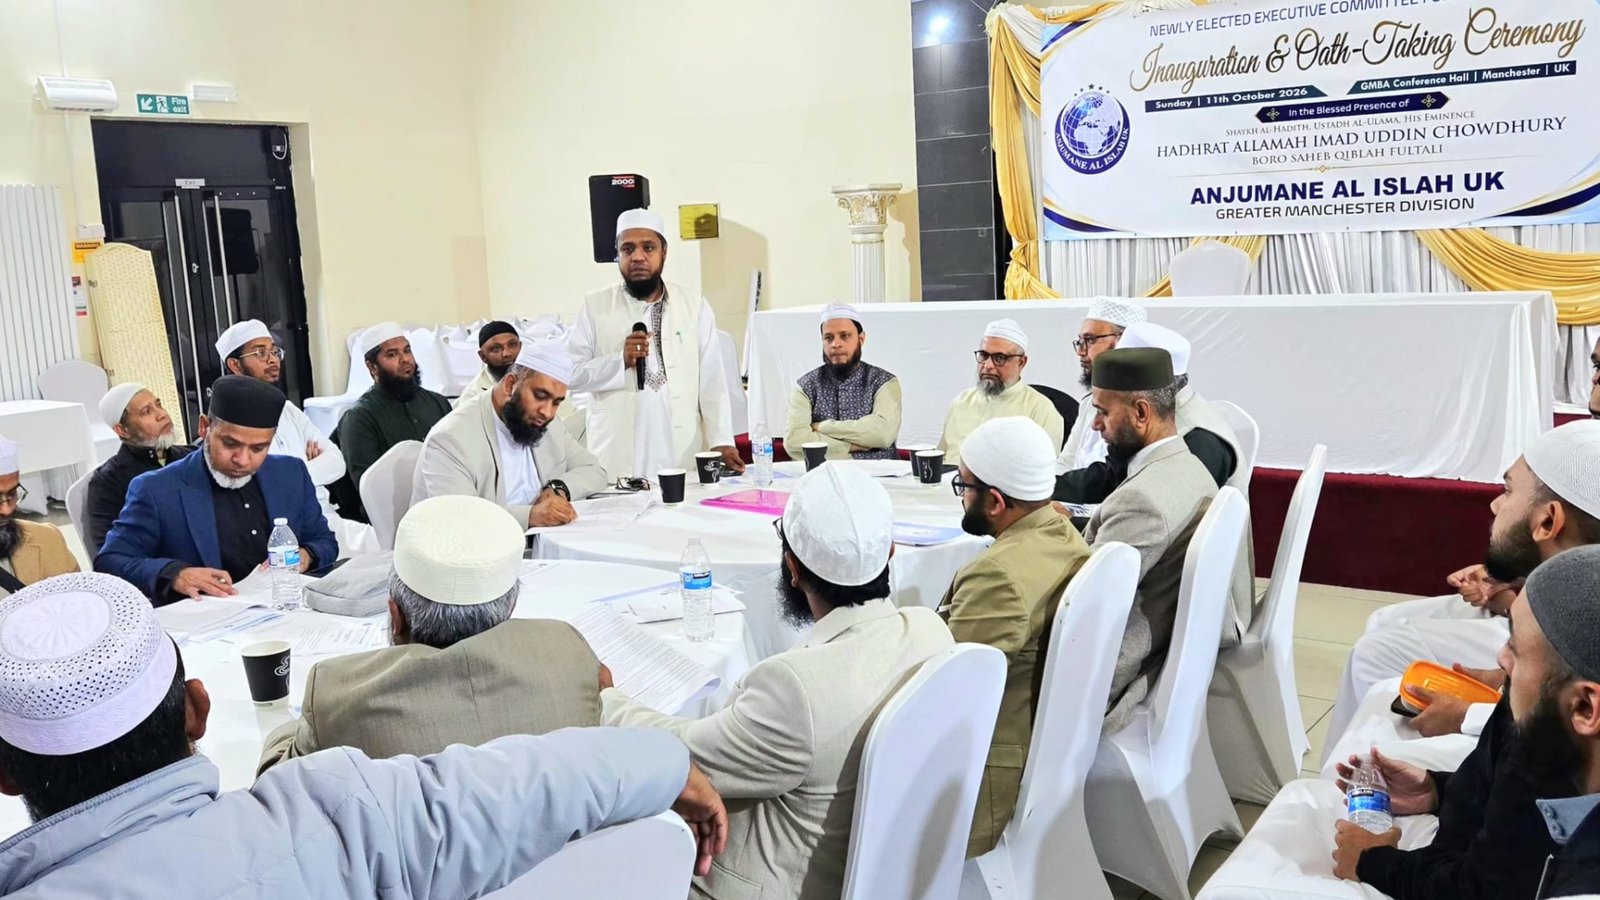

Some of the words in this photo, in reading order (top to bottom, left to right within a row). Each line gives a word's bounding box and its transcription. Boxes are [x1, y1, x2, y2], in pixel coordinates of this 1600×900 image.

[1150, 20, 1194, 37] NEWLY
[1196, 13, 1251, 32] ELECTED
[1254, 3, 1327, 23] EXECUTIVE
[1129, 43, 1262, 94] Inauguration
[1265, 34, 1291, 73] &
[1295, 20, 1457, 70] Oath-Taking
[1464, 7, 1587, 58] Ceremony
[1360, 79, 1391, 91] GMBA
[1393, 75, 1446, 89] Conference
[1449, 71, 1470, 84] Hall
[1482, 67, 1541, 81] Manchester
[1554, 63, 1570, 74] UK
[171, 97, 187, 106] Fire
[172, 105, 188, 114] exit
[1155, 99, 1193, 110] Sunday
[1206, 95, 1229, 105] 11th
[1232, 90, 1276, 103] October
[1279, 87, 1308, 98] 2026
[1288, 108, 1298, 117] In
[1299, 106, 1315, 116] the
[1316, 103, 1352, 116] Blessed
[1354, 100, 1397, 113] Presence
[1398, 98, 1410, 109] of
[1056, 133, 1088, 170] ANJUMANE
[1089, 161, 1104, 170] AL
[1121, 128, 1129, 140] UK
[1157, 141, 1229, 158] HADHRAT
[1233, 136, 1308, 153] ALLAMAH
[1314, 131, 1359, 148] IMAD
[1364, 127, 1427, 143] UDDIN
[1432, 116, 1568, 140] CHOWDHURY
[1252, 154, 1287, 166] BORO
[1291, 151, 1331, 163] SAHEB
[1334, 148, 1386, 161] QIBLAH
[1390, 144, 1444, 156] FULTALI
[1190, 181, 1324, 205] ANJUMANE
[1332, 179, 1365, 199] AL
[1374, 174, 1450, 196] ISLAH
[1463, 171, 1505, 191] UK
[1216, 206, 1282, 220] GREATER
[1285, 201, 1396, 218] MANCHESTER
[1400, 197, 1475, 213] DIVISION
